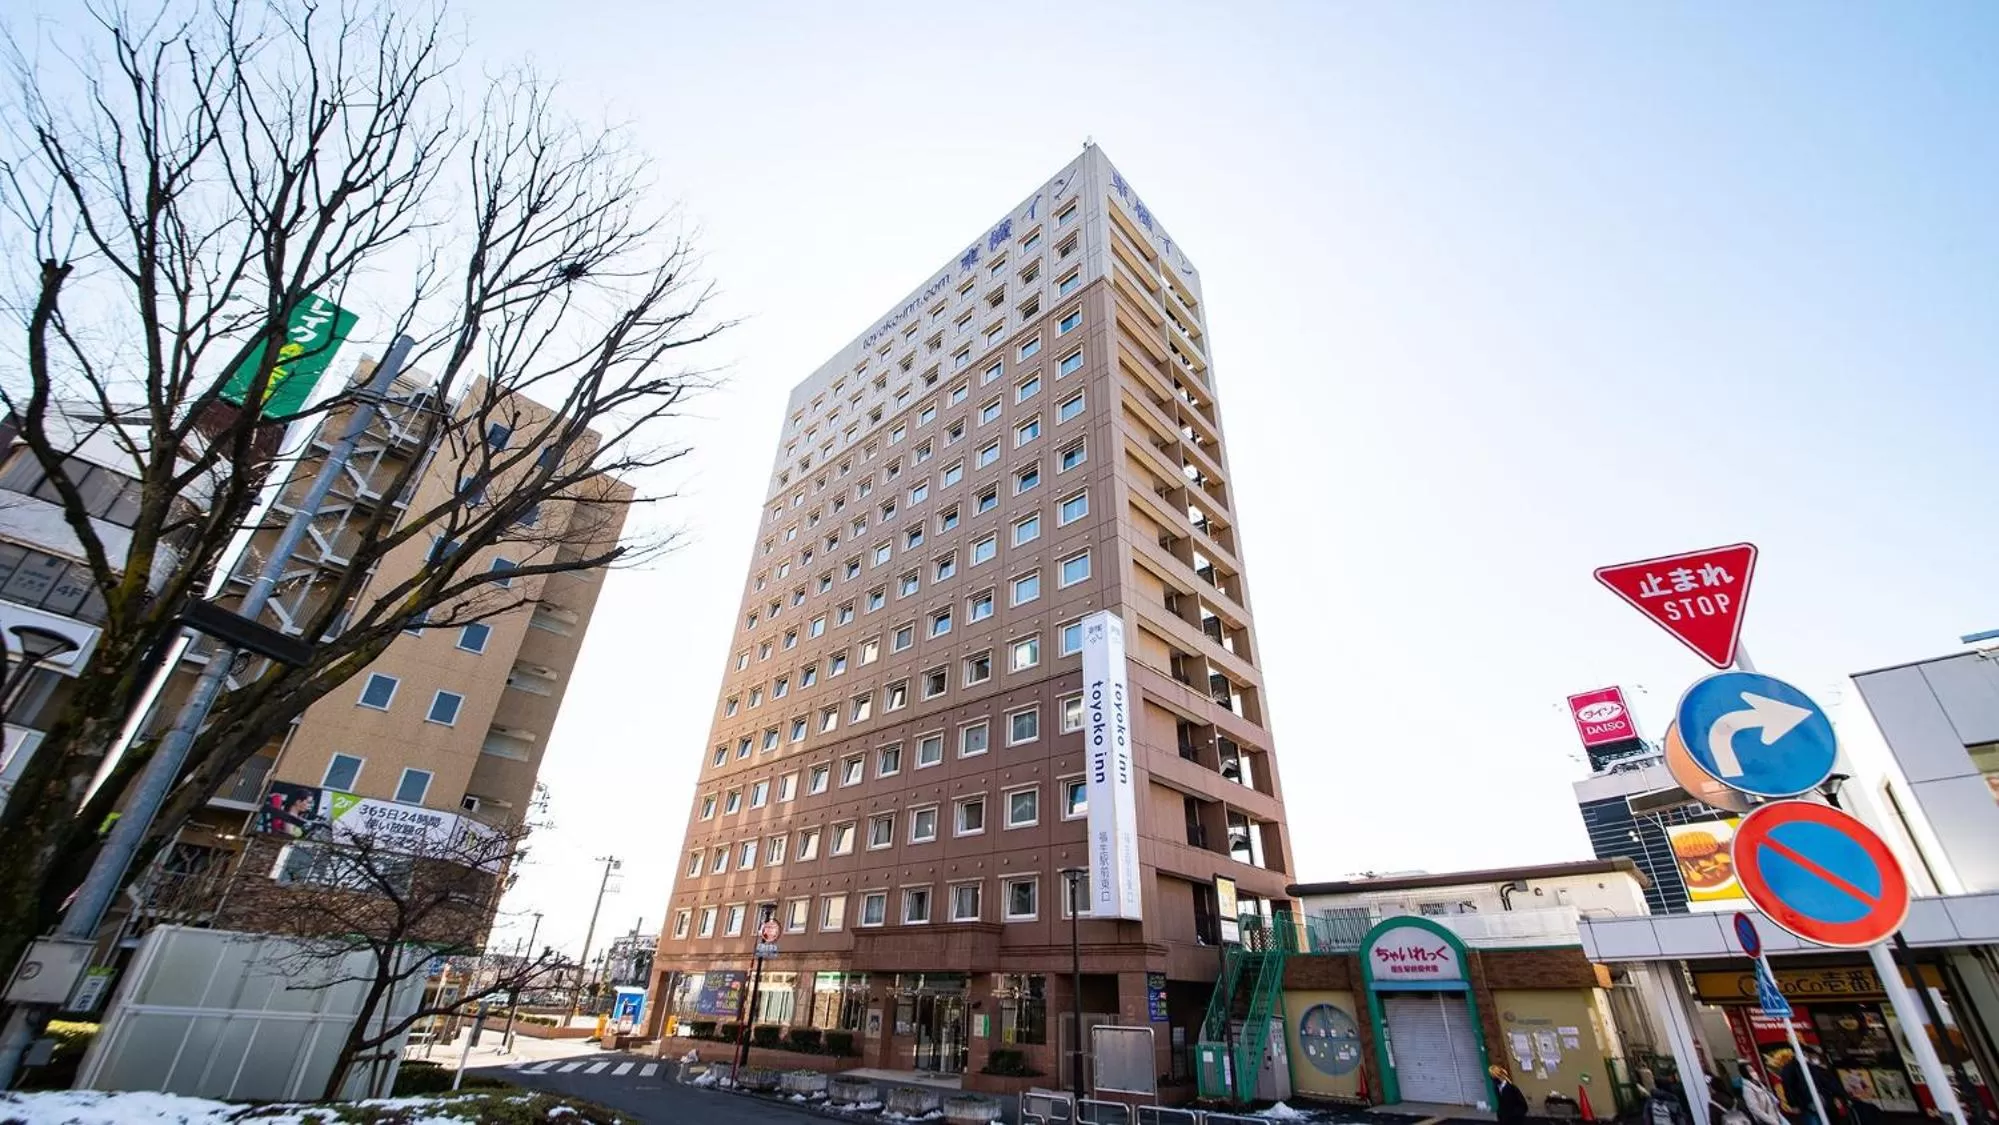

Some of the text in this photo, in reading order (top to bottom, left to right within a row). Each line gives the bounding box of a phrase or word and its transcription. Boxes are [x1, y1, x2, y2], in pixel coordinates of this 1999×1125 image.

[863, 274, 950, 349] toyoko-inn.com
[1639, 562, 1735, 598] 止まれ
[1663, 593, 1731, 621] STOP
[1583, 705, 1620, 719] ダイソー
[1090, 680, 1107, 784] toyoko inn
[1114, 682, 1128, 784] toyoko inn
[1586, 720, 1626, 735] DAISO
[358, 805, 442, 828] 365日24時間
[1375, 945, 1450, 961] ちゃいれっく
